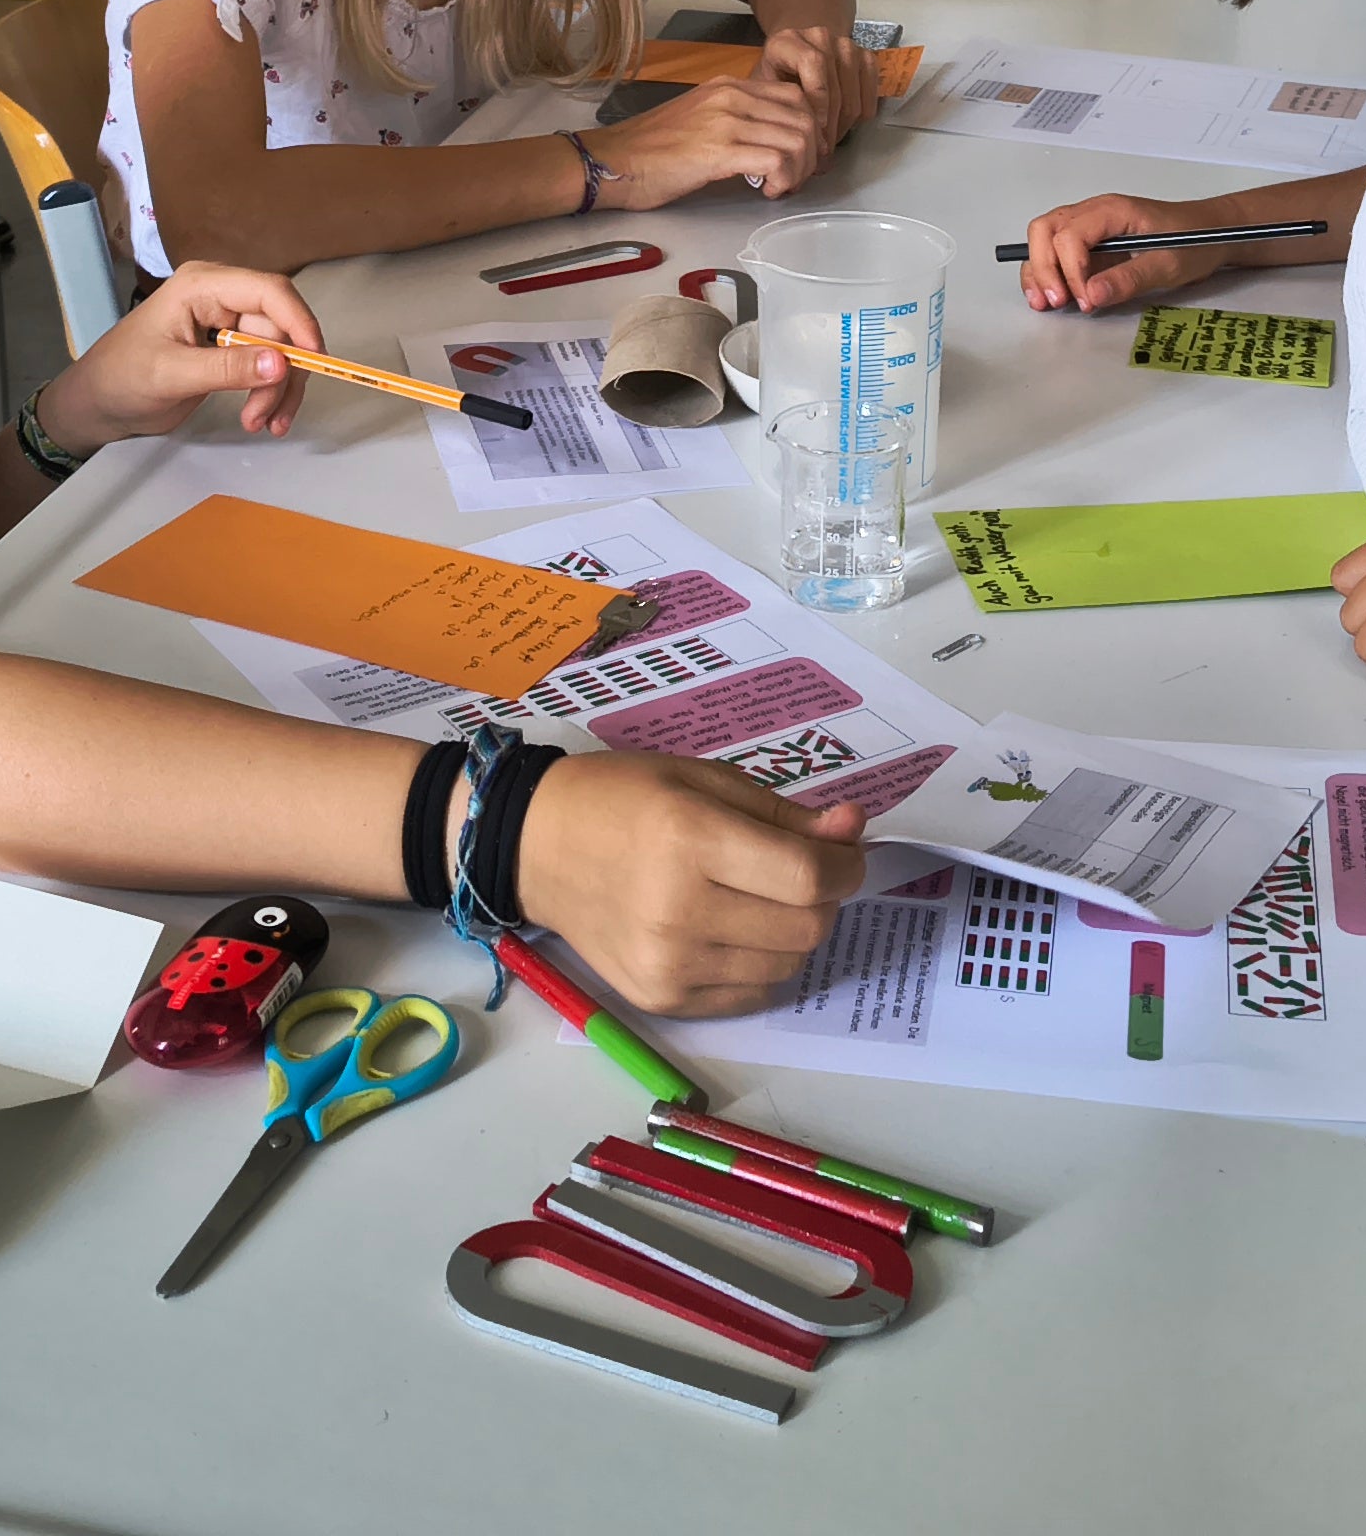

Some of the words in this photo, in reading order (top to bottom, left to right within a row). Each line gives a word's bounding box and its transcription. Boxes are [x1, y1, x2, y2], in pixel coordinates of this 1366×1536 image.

[889, 304, 917, 316] 400
[841, 313, 851, 368] VOLUME
[888, 355, 915, 368] 300
[827, 533, 840, 542] 50
[825, 568, 839, 577] 25
[976, 580, 1011, 605] Auch
[818, 698, 852, 710] Wenn
[646, 720, 692, 738] schauen
[690, 721, 729, 736] ordnen
[744, 719, 775, 732] einen
[663, 735, 687, 745] sich
[690, 732, 732, 749] Magnet
[908, 750, 943, 766] Nagel
[878, 762, 908, 775] nicht
[1332, 785, 1349, 805] Nagel
[1337, 808, 1351, 825] nicht
[1141, 982, 1155, 1014] Magnet
